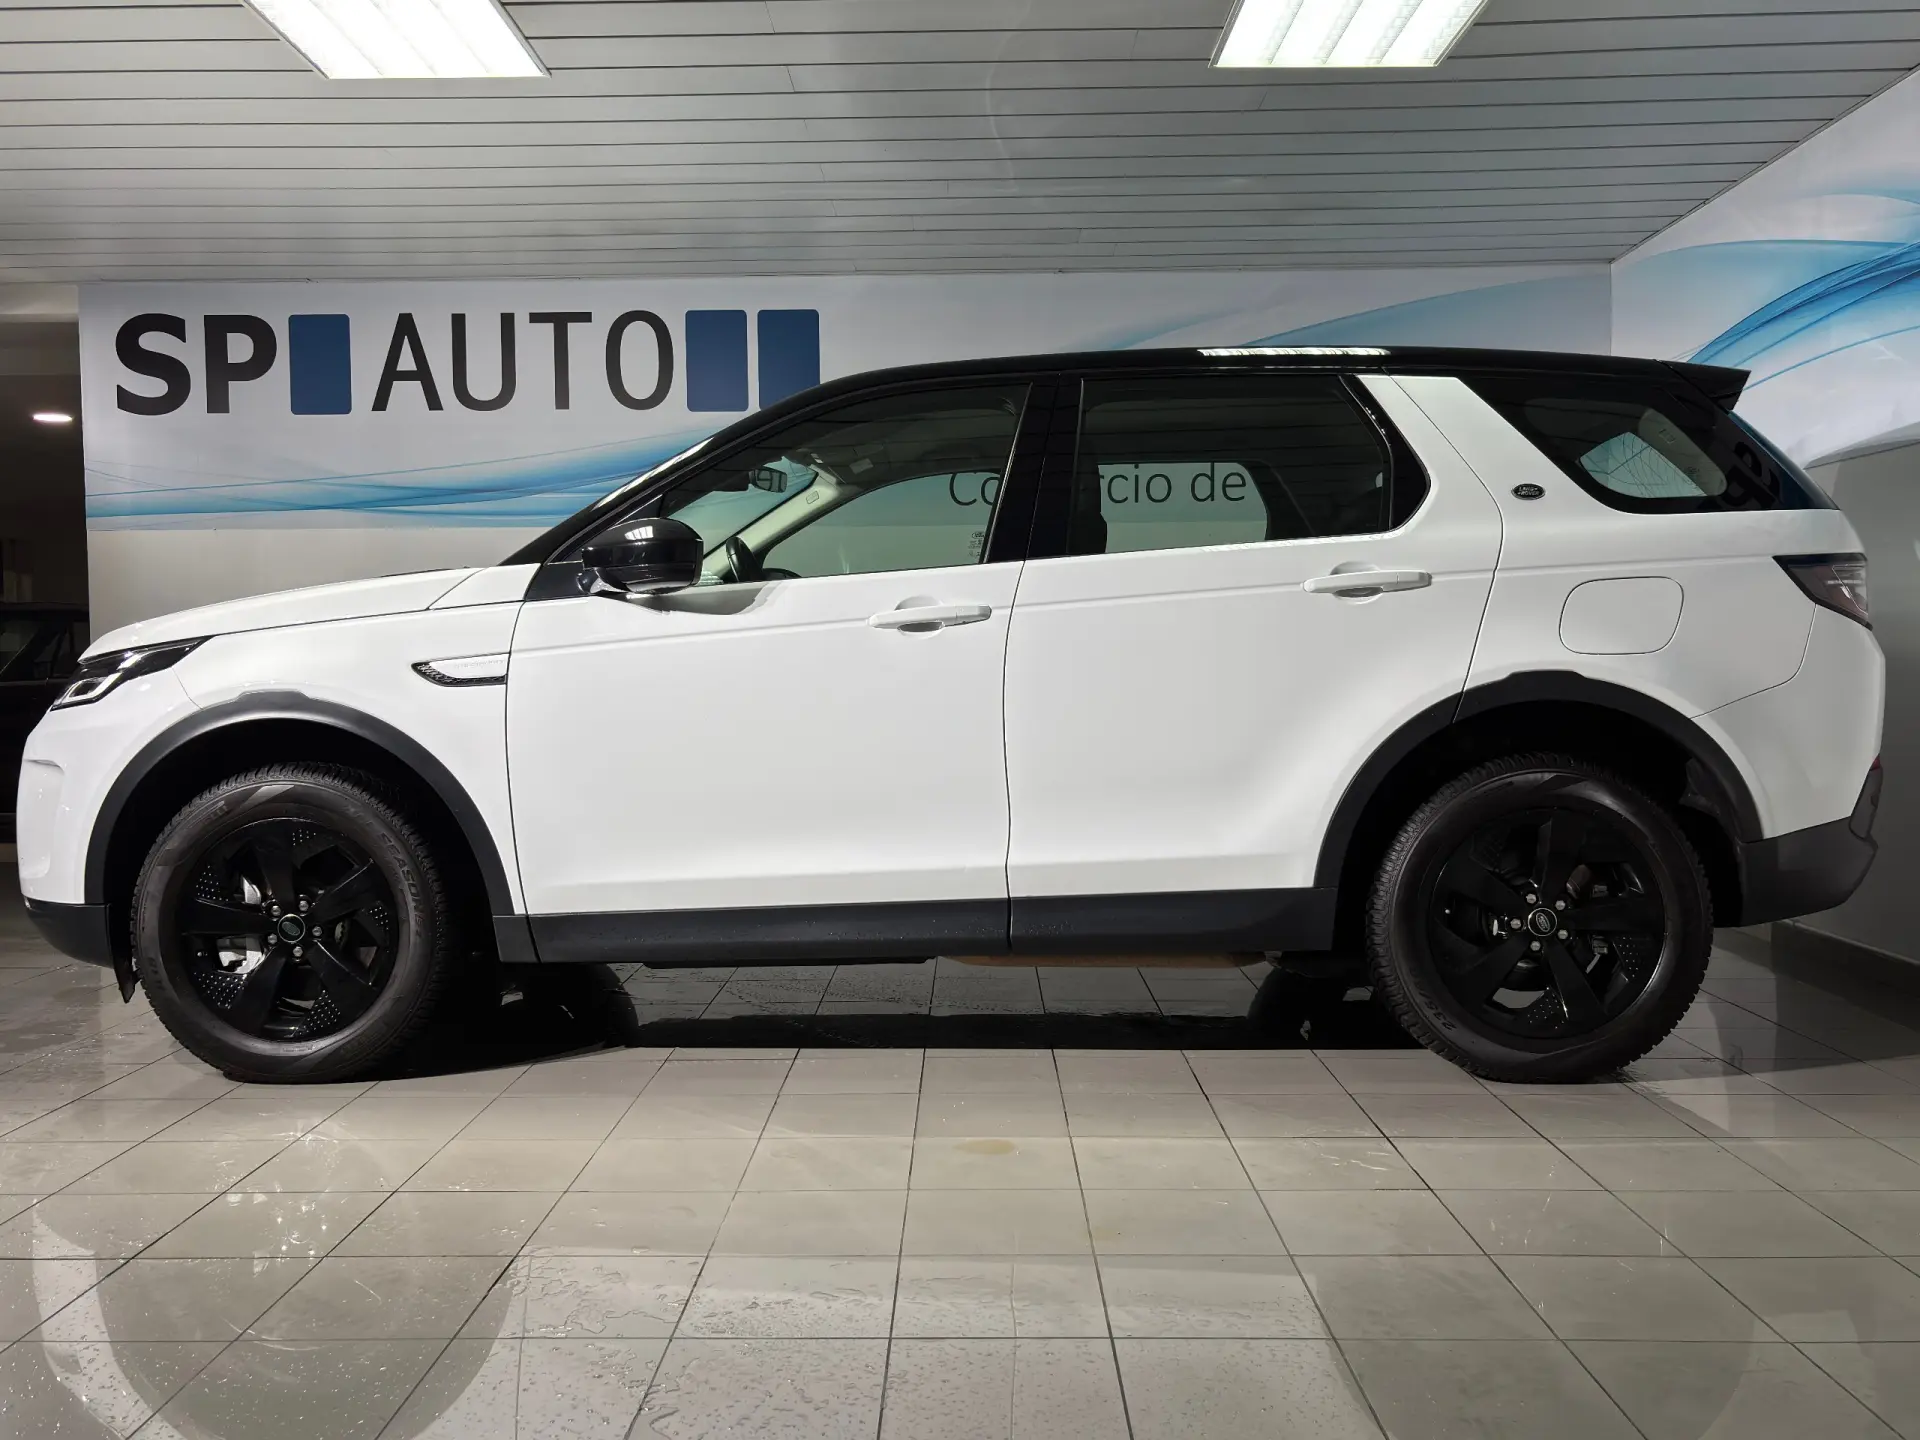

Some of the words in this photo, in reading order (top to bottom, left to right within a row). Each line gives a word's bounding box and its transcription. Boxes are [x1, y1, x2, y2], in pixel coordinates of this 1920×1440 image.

[115, 312, 278, 416] SP
[371, 309, 674, 412] AUTO
[1190, 462, 1247, 503] de
